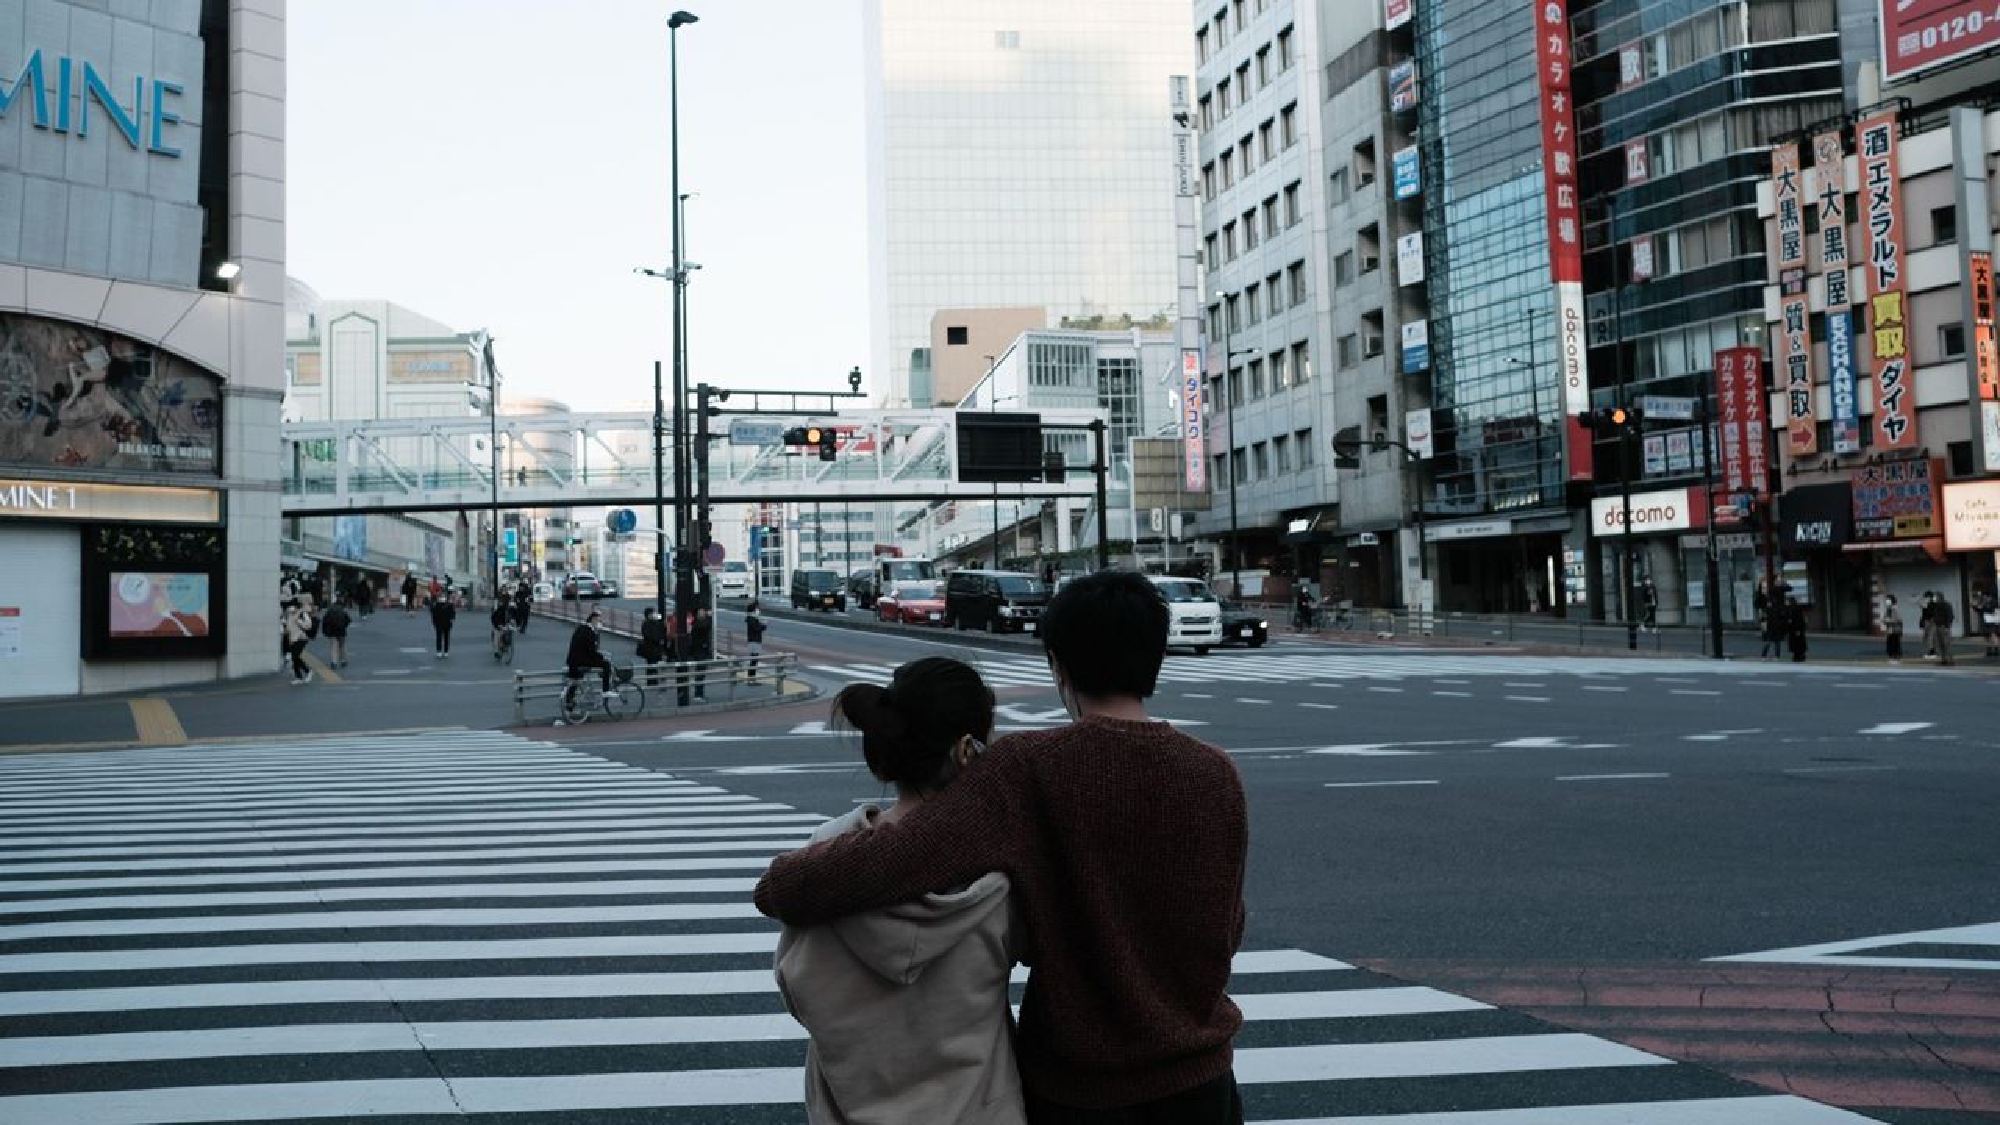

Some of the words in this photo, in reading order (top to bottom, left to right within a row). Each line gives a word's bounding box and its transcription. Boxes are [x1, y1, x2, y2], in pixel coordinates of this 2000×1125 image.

[1777, 165, 1802, 262] 大黒屋
[1819, 181, 1848, 307] 大黒屋
[1566, 307, 1579, 388] docomo
[1830, 314, 1853, 420] EXCHANGE
[68, 487, 76, 510] 1
